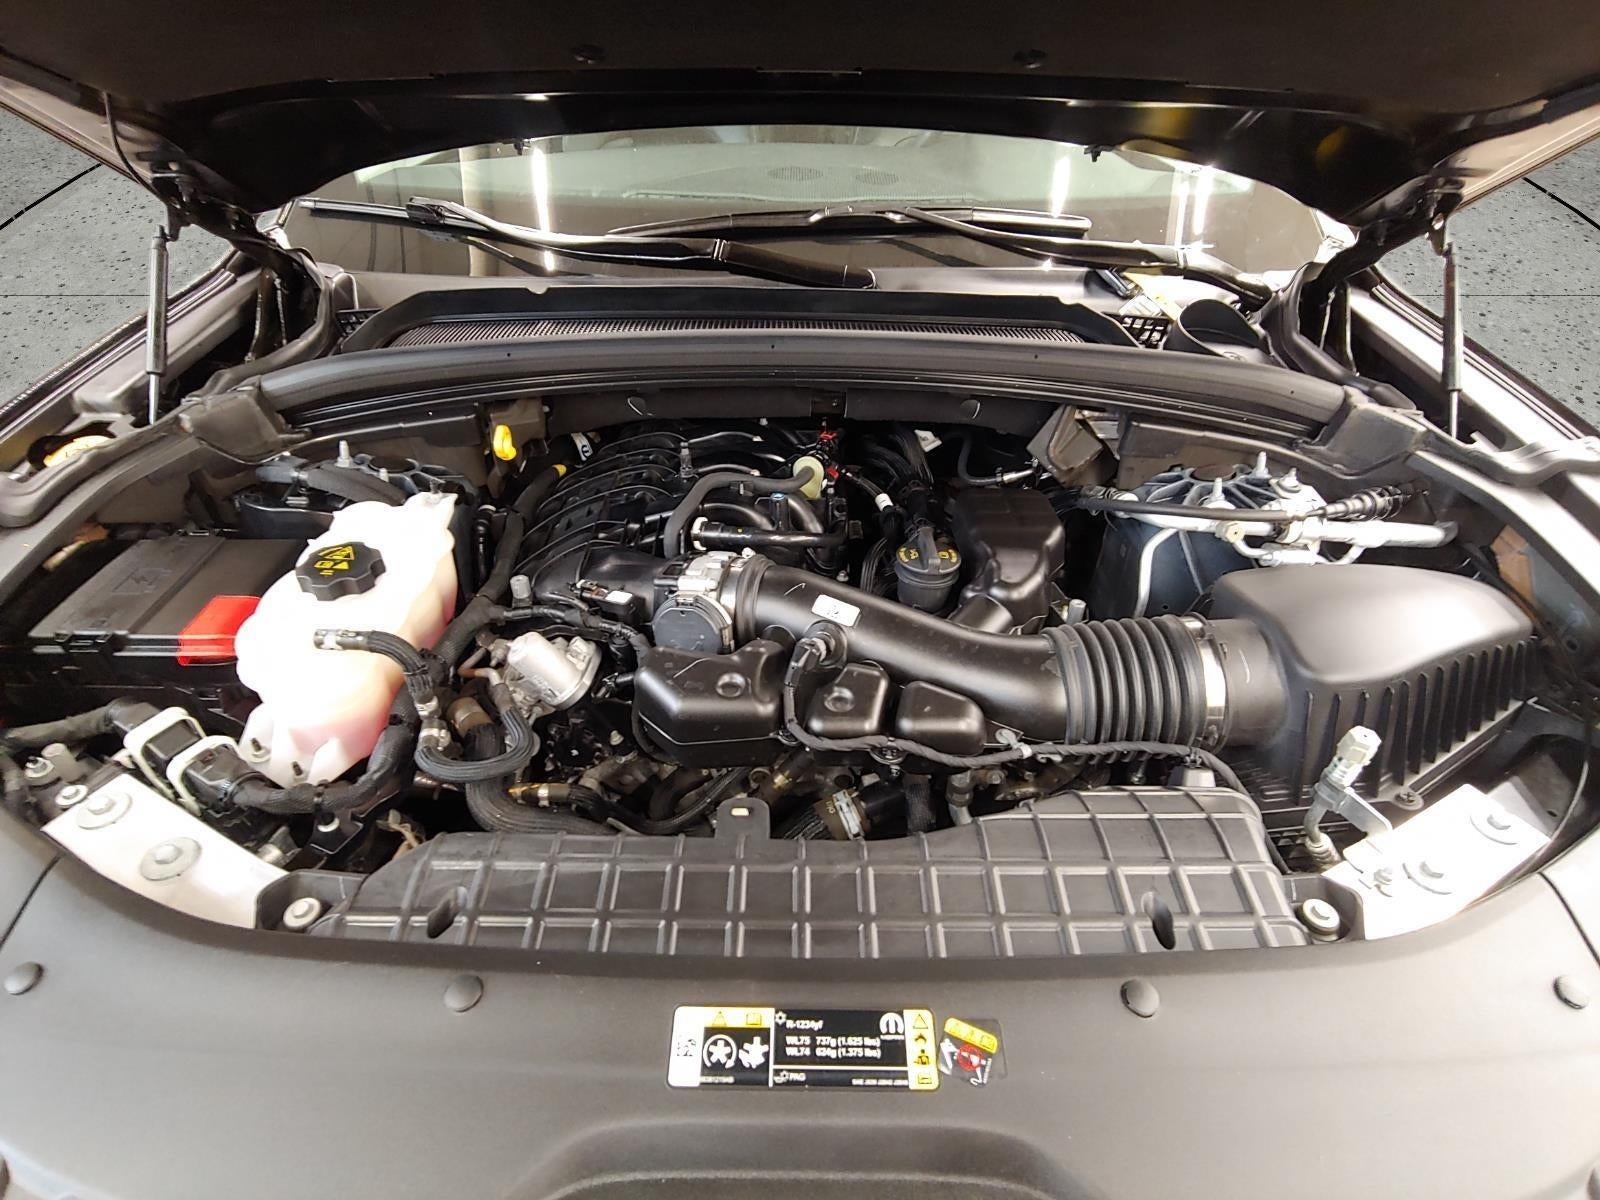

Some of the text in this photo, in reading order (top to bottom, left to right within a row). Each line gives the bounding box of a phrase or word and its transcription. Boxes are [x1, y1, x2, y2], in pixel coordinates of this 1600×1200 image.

[786, 1019, 823, 1031] R-1234yf
[785, 1036, 811, 1045] WL75
[816, 1036, 836, 1047] 737g
[838, 1036, 863, 1047] (1.625
[864, 1037, 880, 1047] lbs)
[785, 1047, 811, 1056] WL74
